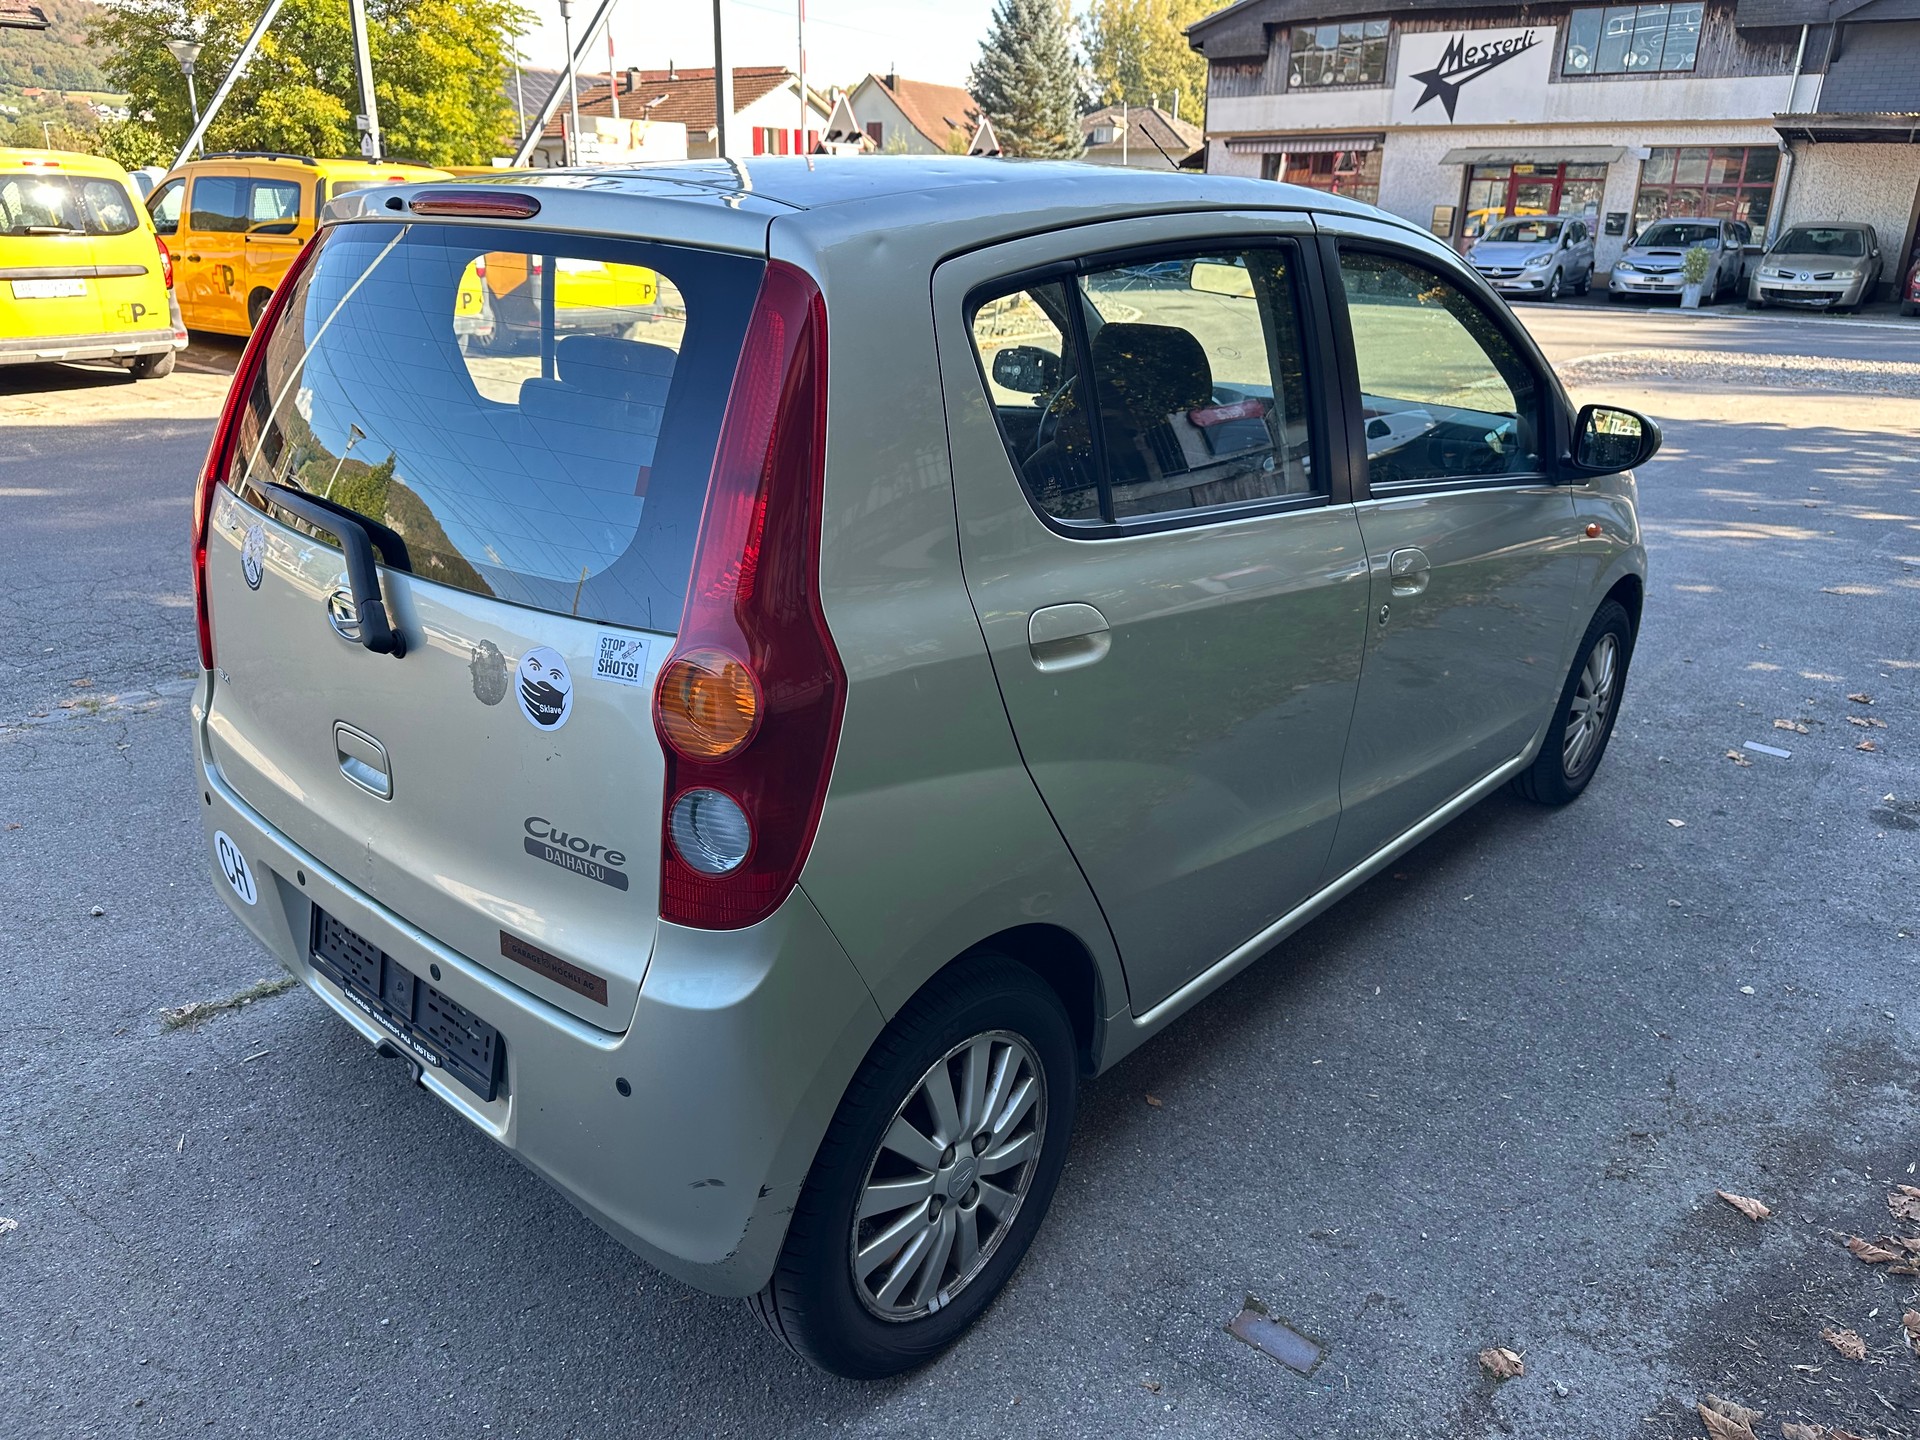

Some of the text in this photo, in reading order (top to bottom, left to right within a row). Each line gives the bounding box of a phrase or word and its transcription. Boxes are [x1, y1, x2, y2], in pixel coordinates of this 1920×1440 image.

[1437, 29, 1535, 74] Messerli
[222, 264, 235, 294] P
[600, 649, 614, 660] THE
[601, 637, 626, 651] STOP
[597, 658, 639, 678] SHOTS!
[539, 704, 562, 715] Sklave
[523, 816, 627, 867] Cuore
[219, 836, 252, 901] CH
[544, 846, 605, 881] DAIHATSU
[511, 944, 541, 965] GARAGE
[582, 980, 595, 991] AG
[413, 1041, 437, 1065] USTER
